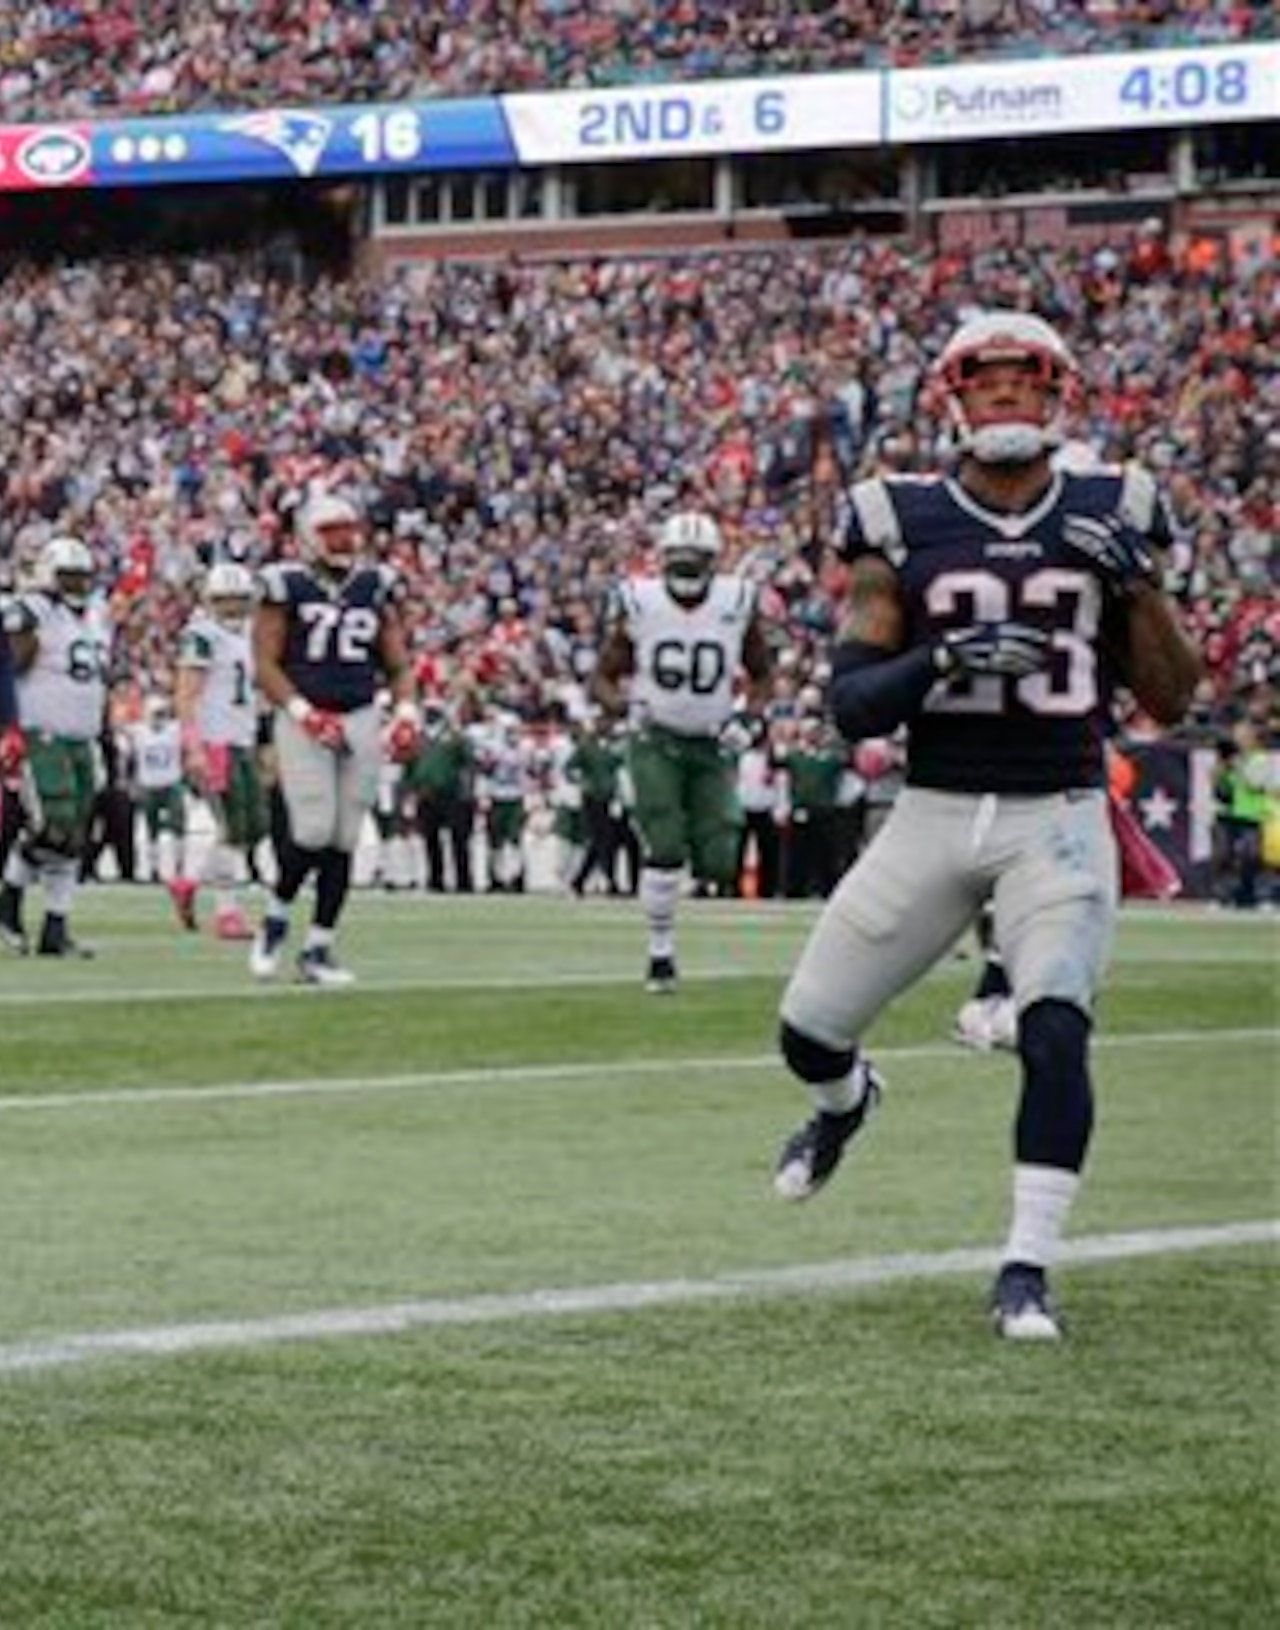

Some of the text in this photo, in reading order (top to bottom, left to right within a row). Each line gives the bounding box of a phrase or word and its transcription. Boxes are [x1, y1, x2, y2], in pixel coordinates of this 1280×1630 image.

[933, 83, 1062, 116] Putnam
[1119, 60, 1248, 112] 4:08
[350, 111, 421, 163] 16
[578, 100, 694, 146] 2ND
[754, 90, 785, 135] 6
[298, 602, 380, 662] 72
[920, 567, 1101, 714] 23
[650, 640, 722, 694] 60
